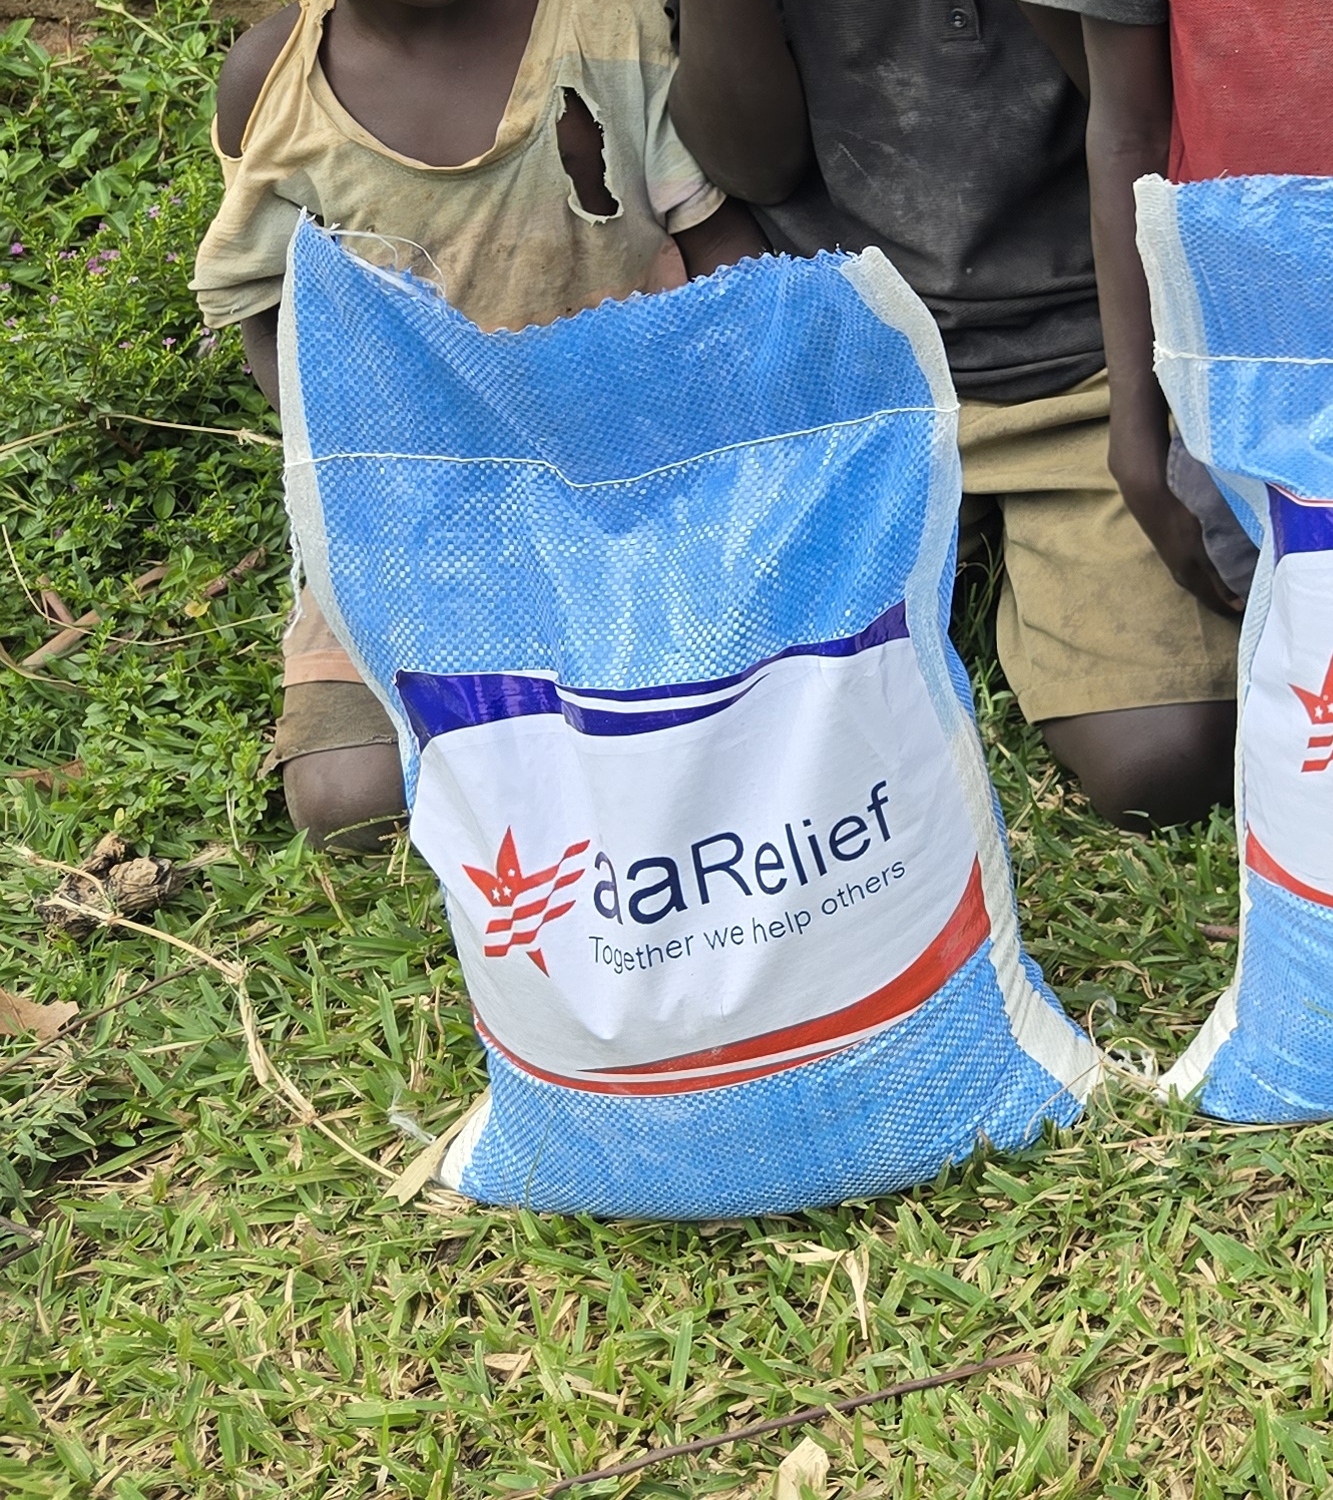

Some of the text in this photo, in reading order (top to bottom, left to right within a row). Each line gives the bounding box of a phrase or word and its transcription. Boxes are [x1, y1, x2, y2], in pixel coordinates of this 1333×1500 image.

[593, 780, 891, 925] aaRelief
[588, 861, 905, 975] Together we help others
